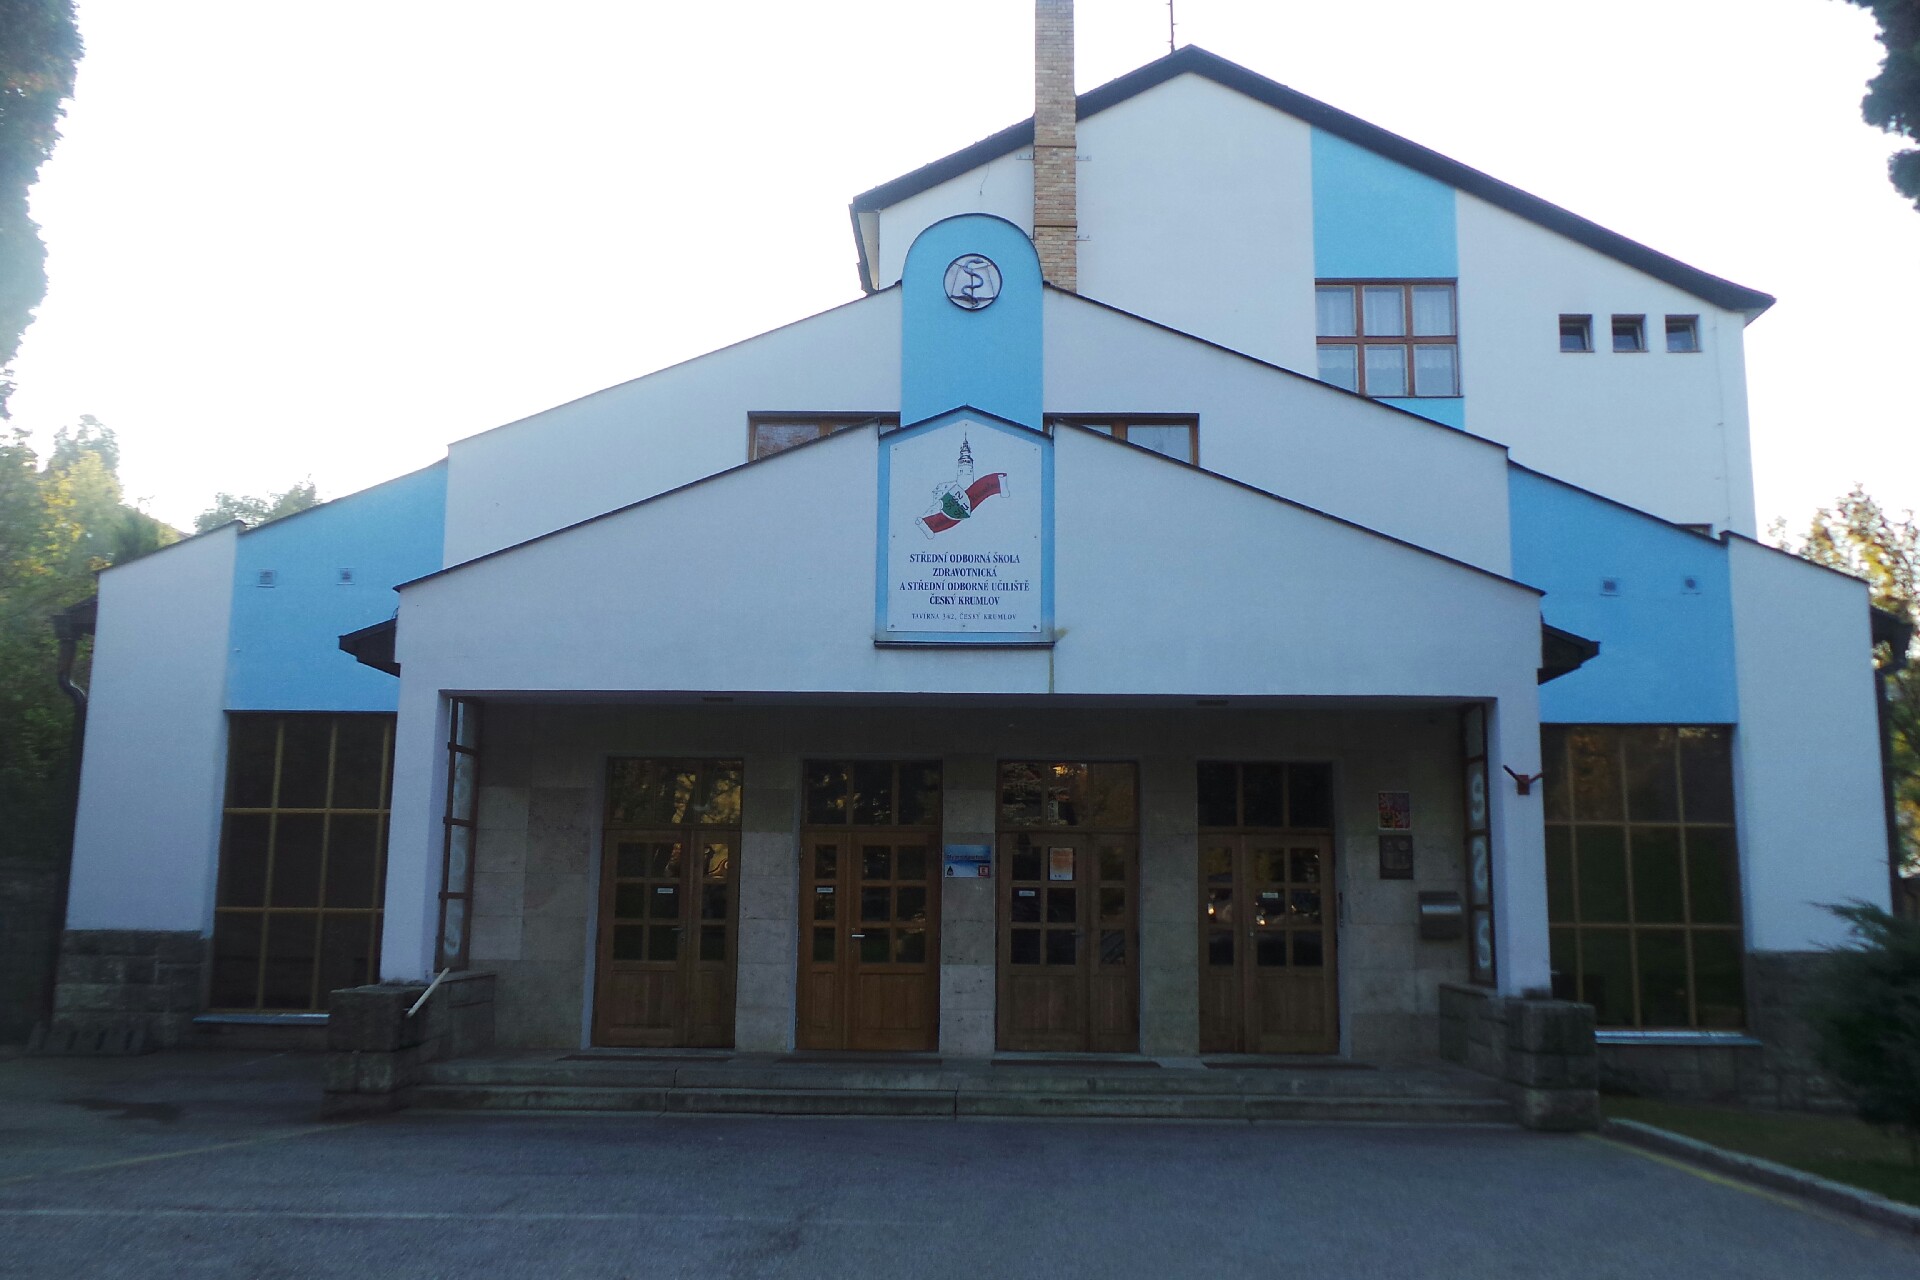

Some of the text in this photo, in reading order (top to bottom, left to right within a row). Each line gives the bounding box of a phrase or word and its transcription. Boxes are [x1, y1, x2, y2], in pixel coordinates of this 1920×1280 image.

[909, 551, 1020, 564] STŘEDNÍ ODBORNÁ ŠKOLA
[932, 565, 997, 577] ZDRAVOTNICKÁ
[899, 579, 1030, 592] A STŘEDNÍ ODBORNÉ UČILIŠTĚ
[929, 593, 1000, 606] ČESKÝ KRUMLOV
